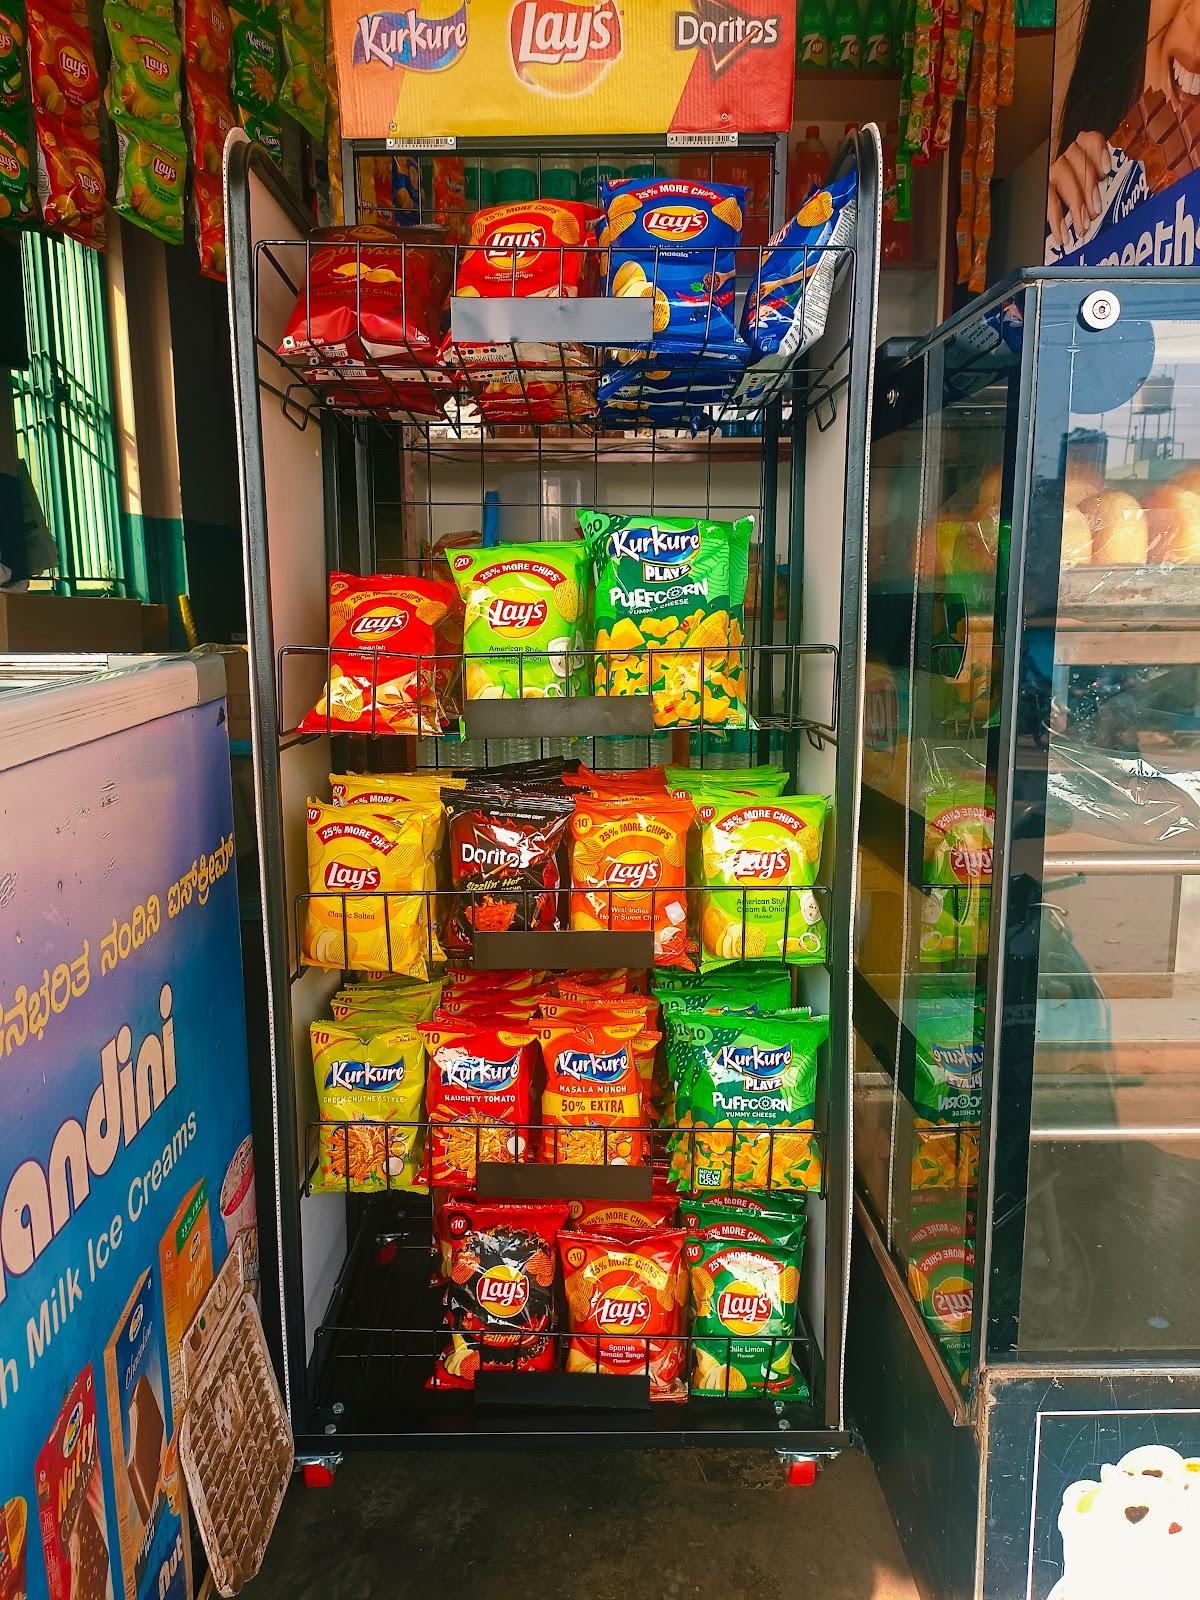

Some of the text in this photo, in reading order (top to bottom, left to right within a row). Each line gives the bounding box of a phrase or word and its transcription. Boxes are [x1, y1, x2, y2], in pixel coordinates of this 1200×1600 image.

[518, 1, 615, 63] Lay's
[678, 15, 778, 46] Doritos
[62, 52, 88, 77] Lay's
[145, 55, 168, 76] Lay's
[154, 158, 176, 179] Lay's
[76, 172, 100, 194] Lay's
[636, 184, 718, 200] 25% MORE CHIPS
[506, 205, 531, 214] MORE
[648, 213, 703, 233] Lay's
[488, 230, 543, 259] Lay's
[480, 563, 559, 581] 25% MORE CHIPS
[645, 564, 690, 581] PLAYZ
[351, 592, 371, 604] 25%
[400, 592, 423, 603] CHIPS
[609, 578, 709, 609] PUFFCORN
[489, 600, 545, 629] Lay's
[628, 598, 689, 615] YUMMY CHEESE
[354, 614, 405, 634] Lay's
[369, 795, 394, 803] MORE
[722, 810, 800, 831] 25% MORE CHIPS
[322, 826, 372, 839] 25% MORE
[600, 822, 672, 842] 25% MORE CHIPS
[609, 860, 659, 888] Lay's
[737, 850, 787, 880] Lay's
[327, 863, 378, 891] Lay's
[771, 897, 785, 906] Styl
[353, 911, 375, 920] Salted
[101, 894, 161, 976] ನಂದಿನಿ
[559, 1085, 627, 1093] MASALA MUNCH
[745, 1078, 783, 1090] PLAYZ
[324, 1096, 346, 1104] GREEN
[348, 1095, 381, 1103] CHUTNEY
[444, 1094, 516, 1103] NAUGHTY TOMATO
[561, 1099, 625, 1114] 50% EXTRA
[712, 1092, 792, 1112] PUFFCORN
[0, 982, 178, 1292] andini
[724, 1197, 746, 1207] MORE
[606, 1211, 628, 1221] MORE
[26, 1110, 198, 1369] Milk Ice Creams
[722, 1226, 746, 1237] MORE
[481, 1278, 526, 1307] Lay's
[600, 1299, 647, 1326] Lay's
[722, 1293, 770, 1322] Lay's
[608, 1344, 635, 1352] Spanish
[625, 1351, 644, 1359] Tango
[745, 1345, 765, 1353] Limón
[58, 1412, 95, 1522] Nutty
